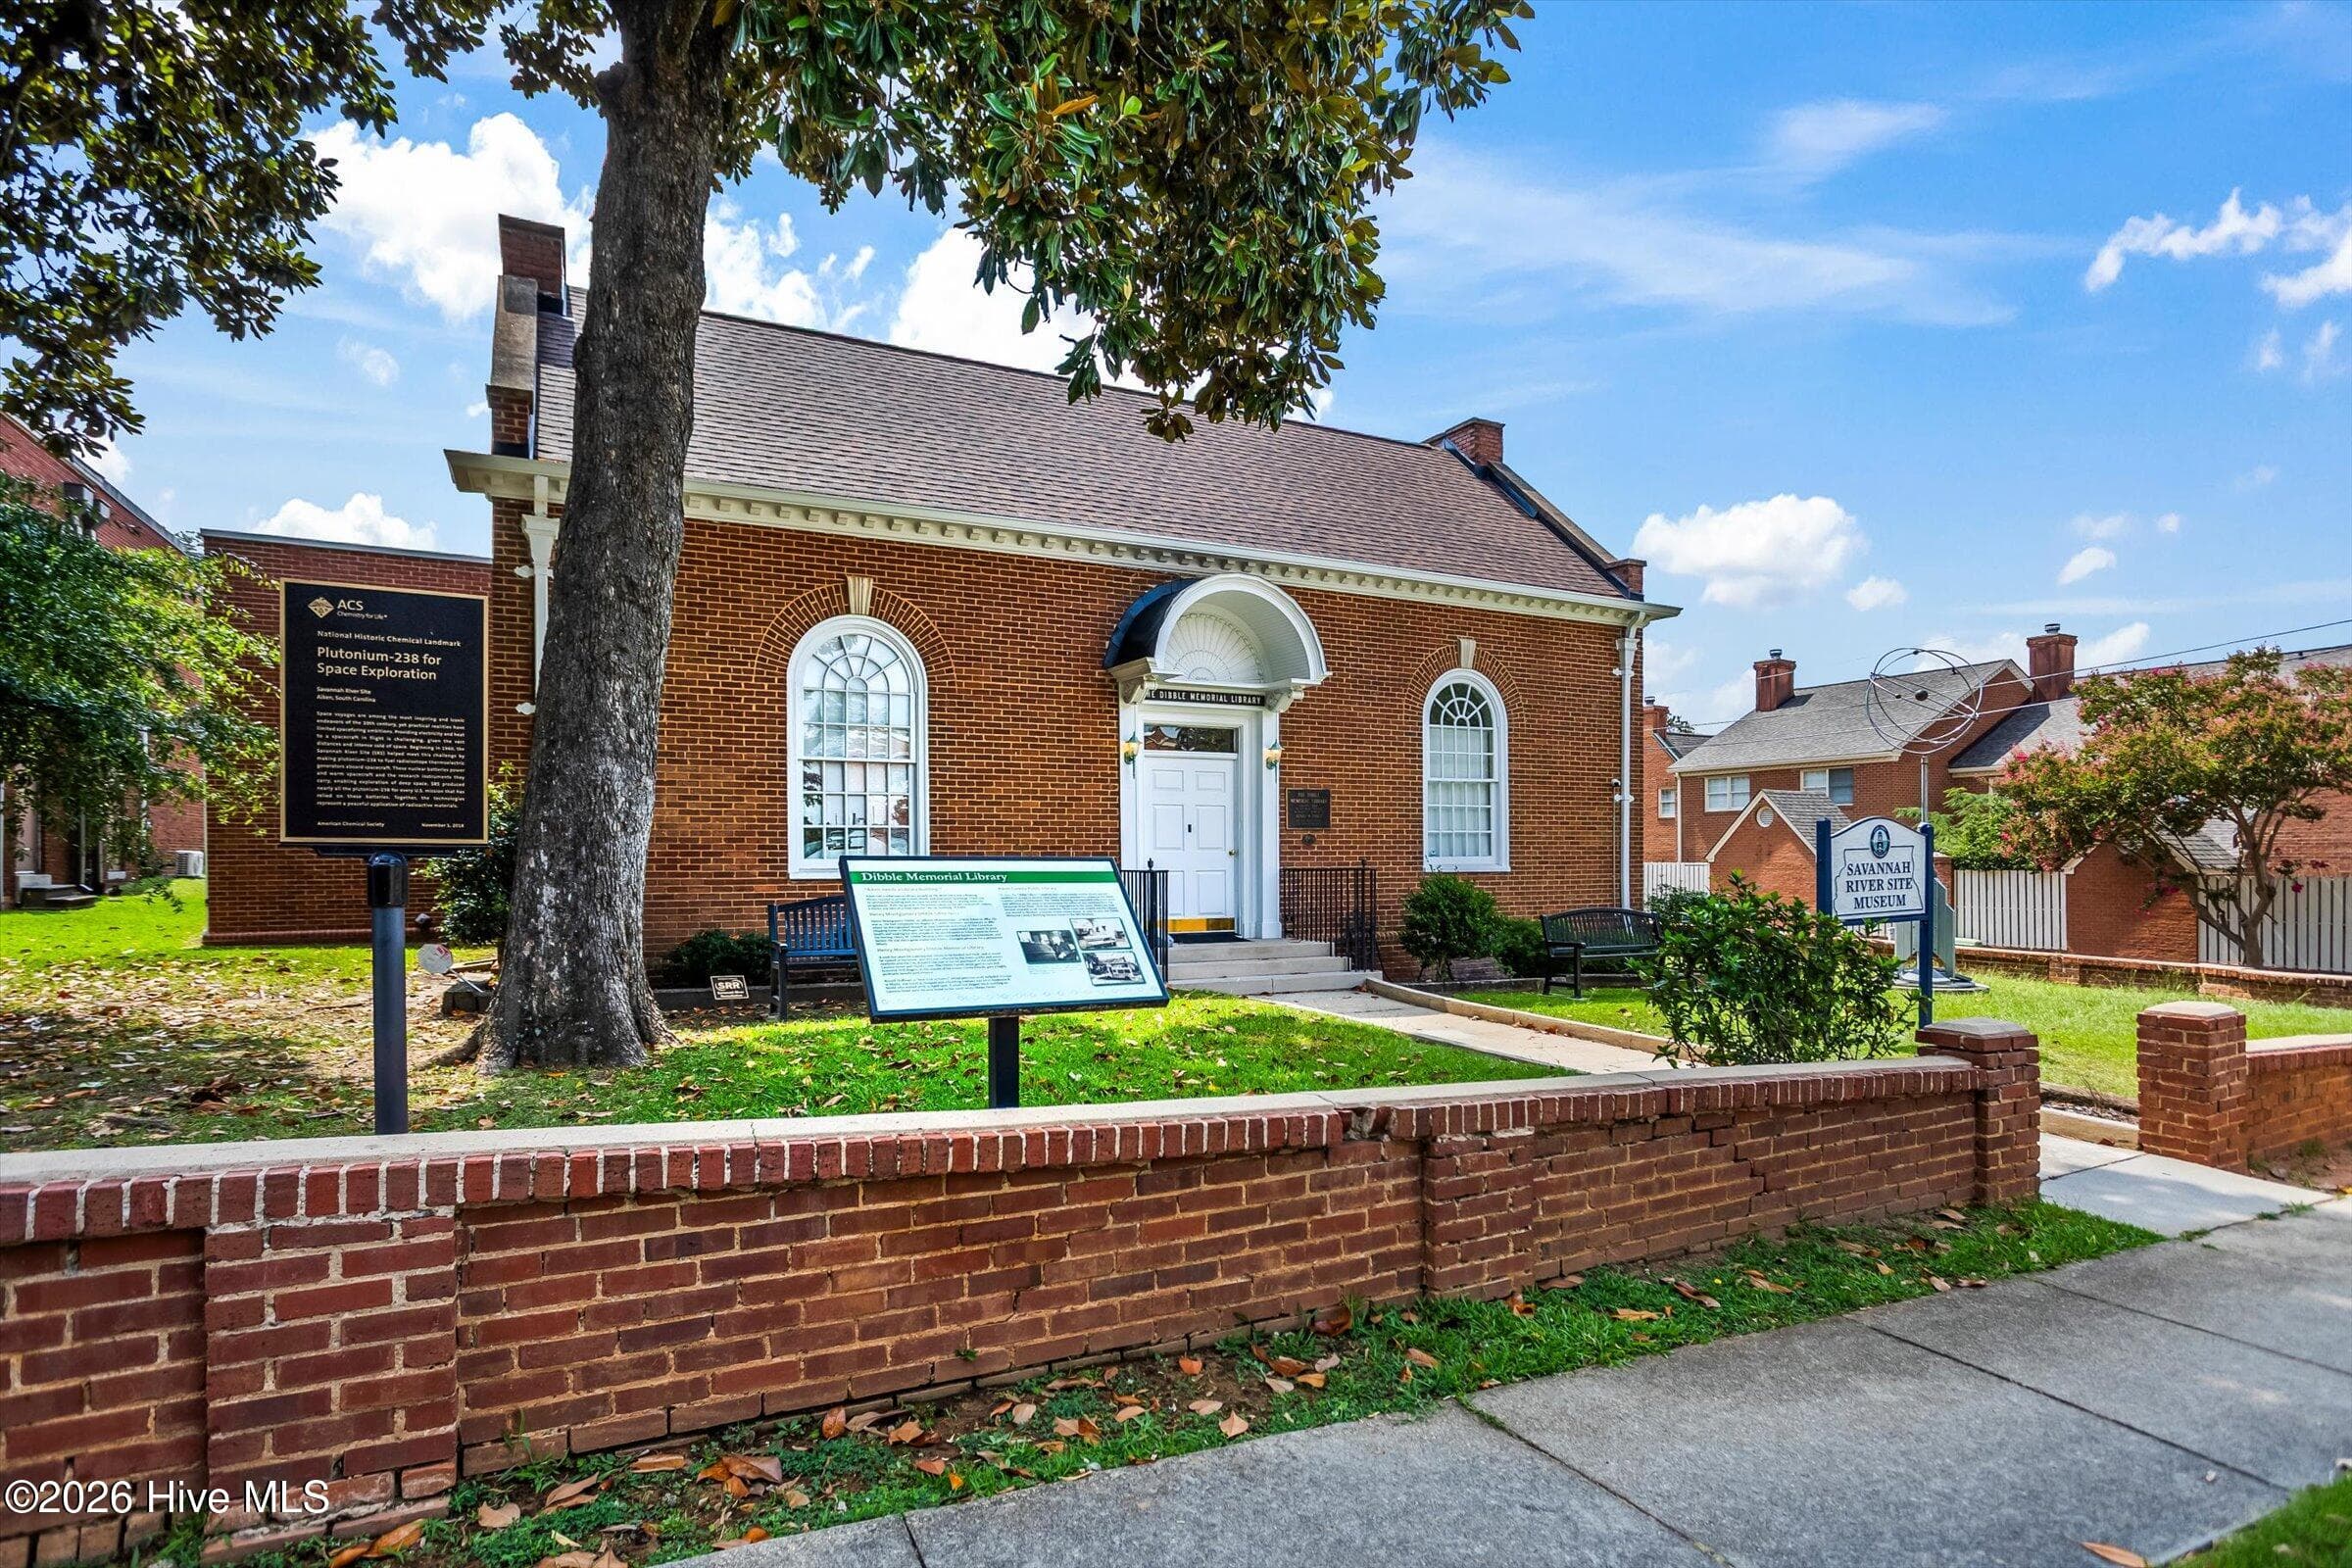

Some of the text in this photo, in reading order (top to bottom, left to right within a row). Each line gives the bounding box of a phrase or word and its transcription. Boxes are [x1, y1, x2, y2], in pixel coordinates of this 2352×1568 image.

[337, 599, 364, 611] ACS
[337, 611, 365, 619] Chemistry
[317, 631, 461, 647] National Historic Chemical Landmark
[317, 647, 442, 665] Plutonium-238 for
[317, 662, 437, 680] Space Exploration
[1160, 690, 1186, 700] DIBBLE
[1190, 692, 1227, 703] MEMORIAL
[1231, 694, 1262, 704] LIBRARY
[1847, 861, 1911, 876] SAVANNAH
[861, 872, 1008, 883] Dibble Memorial Library
[1846, 877, 1913, 893] RIVER SITE
[1854, 894, 1906, 909] MUSEUM
